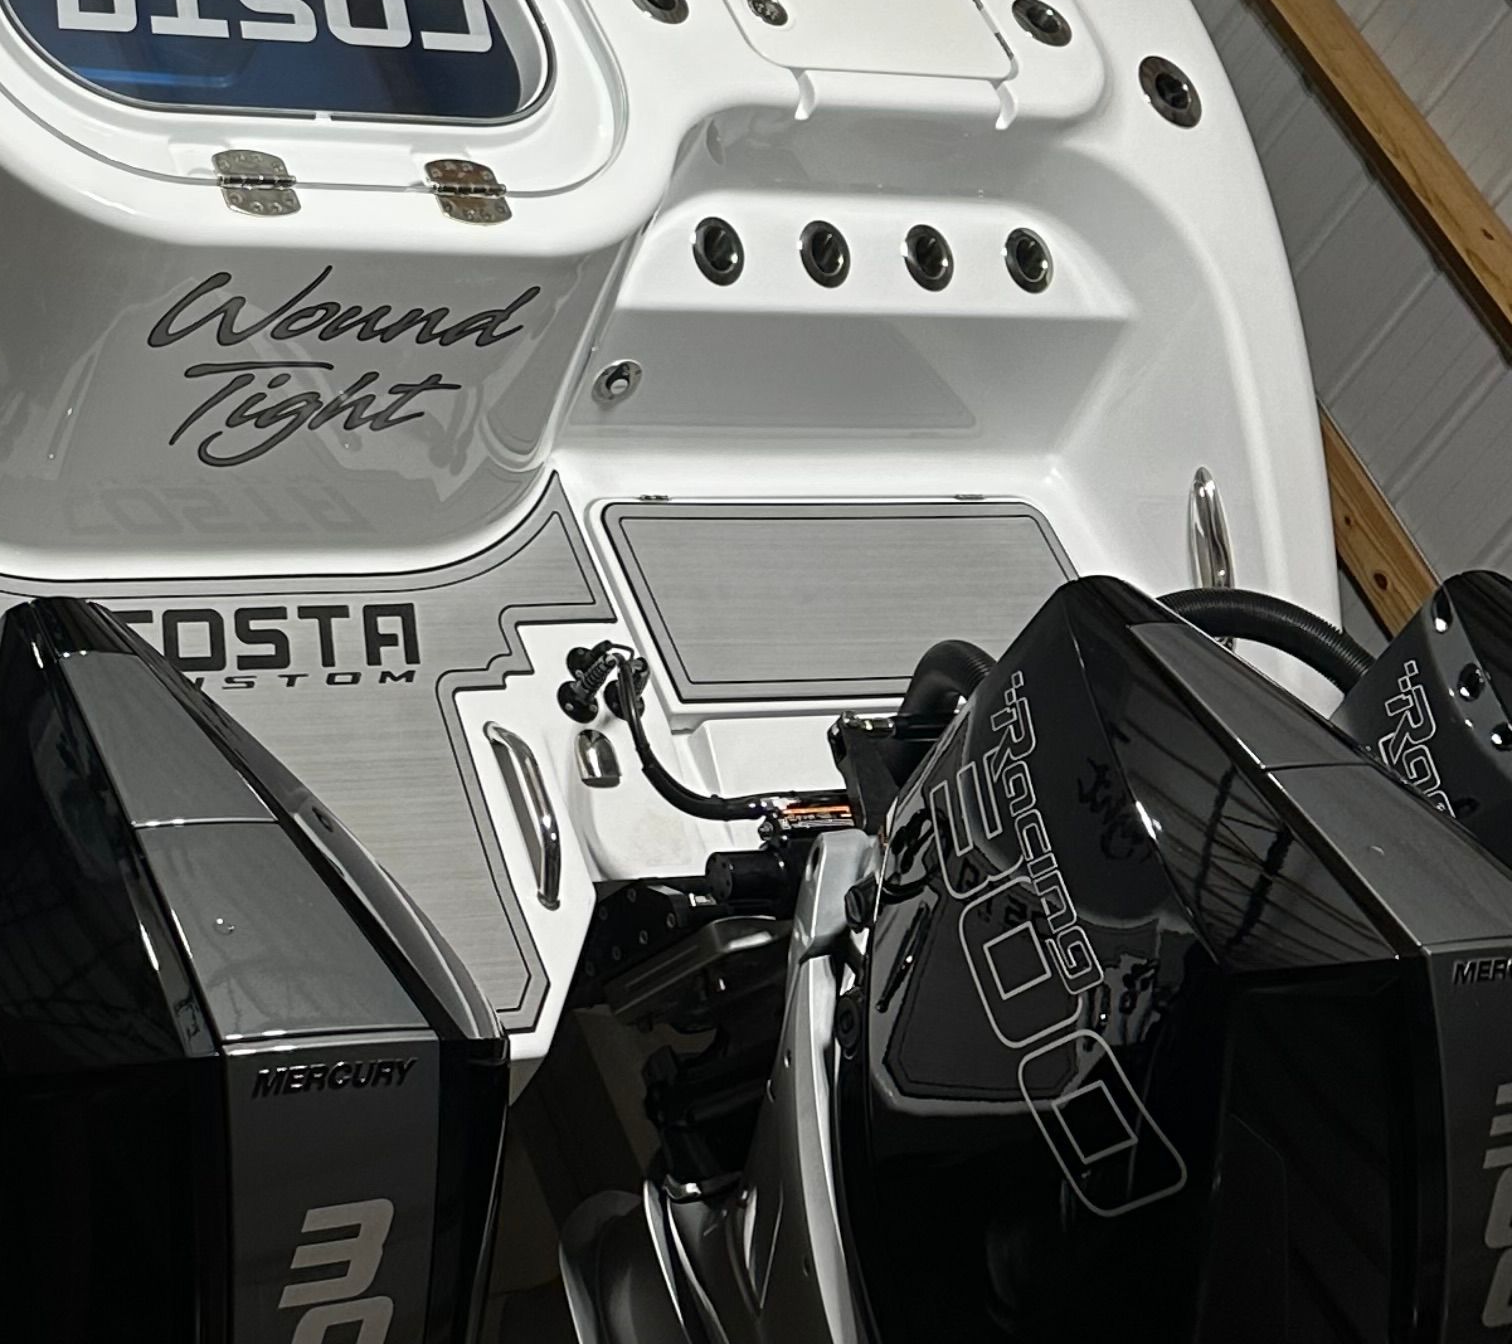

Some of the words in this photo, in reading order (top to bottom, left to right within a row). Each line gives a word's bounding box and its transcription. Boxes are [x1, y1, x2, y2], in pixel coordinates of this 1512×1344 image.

[147, 265, 541, 348] Wound
[168, 361, 463, 468] Tight
[194, 669, 416, 693] STOM
[929, 759, 1188, 1218] 300
[251, 1055, 417, 1099] MERCURY
